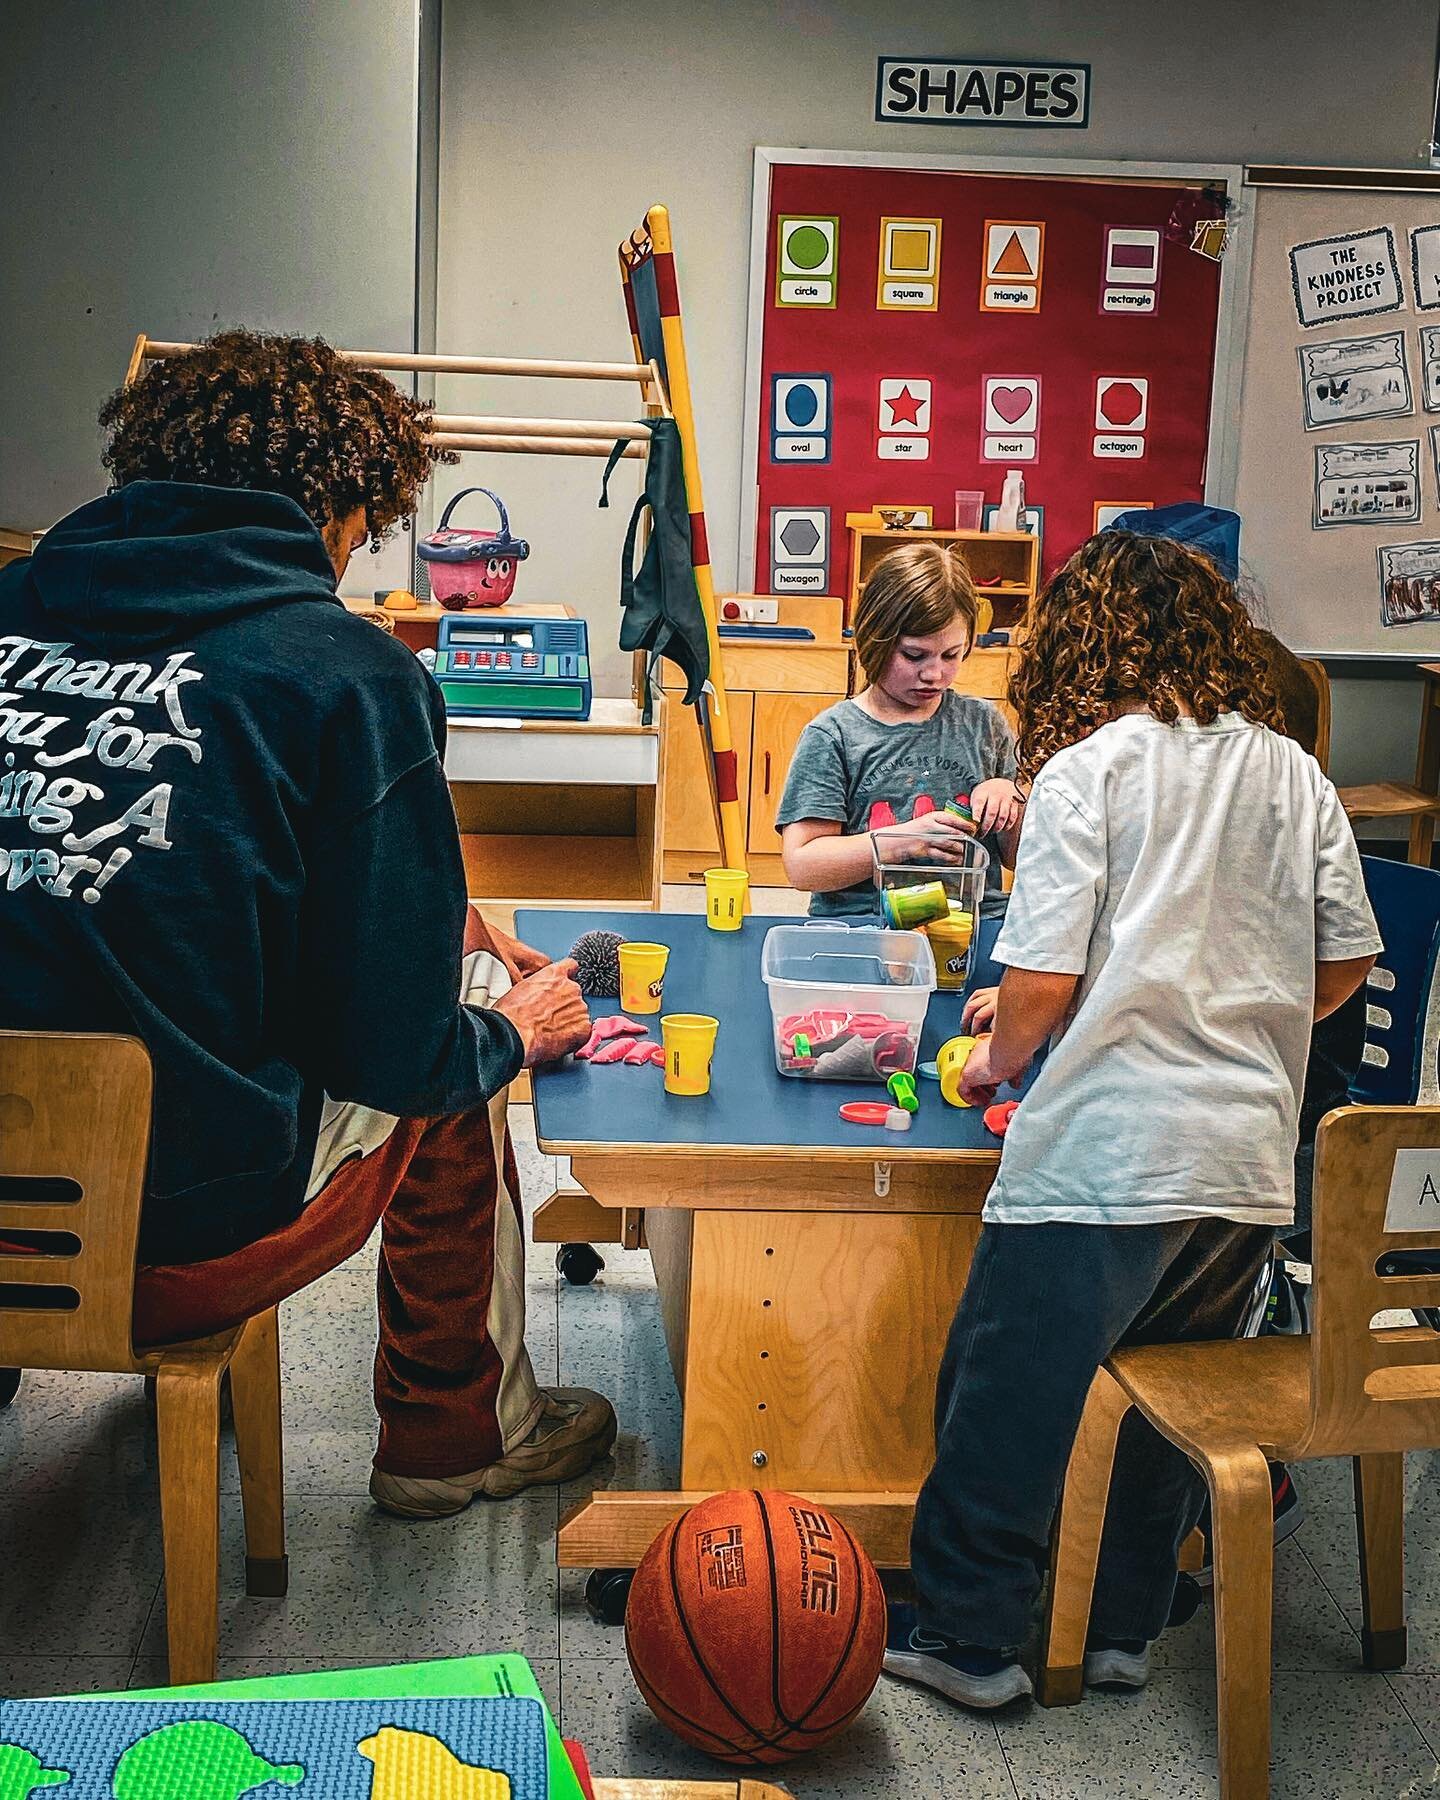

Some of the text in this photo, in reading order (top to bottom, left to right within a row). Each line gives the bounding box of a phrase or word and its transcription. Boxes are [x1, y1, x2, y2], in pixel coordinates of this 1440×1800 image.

[886, 67, 1080, 119] SHAPES
[1329, 247, 1357, 266] THE
[1307, 261, 1385, 290] KINDNESS
[794, 285, 818, 297] circle
[892, 287, 924, 300] square
[993, 290, 1029, 304] triangle
[1316, 281, 1381, 308] PROJECT
[1107, 293, 1152, 307] rectangle
[791, 442, 811, 453] oval
[894, 442, 913, 453] star
[997, 441, 1023, 453] heart
[1100, 440, 1138, 454] octagon
[780, 573, 820, 587] hexagon
[0, 635, 204, 738] Thank
[34, 706, 202, 772] for
[62, 782, 173, 851] A
[798, 1507, 841, 1617] ELITE
